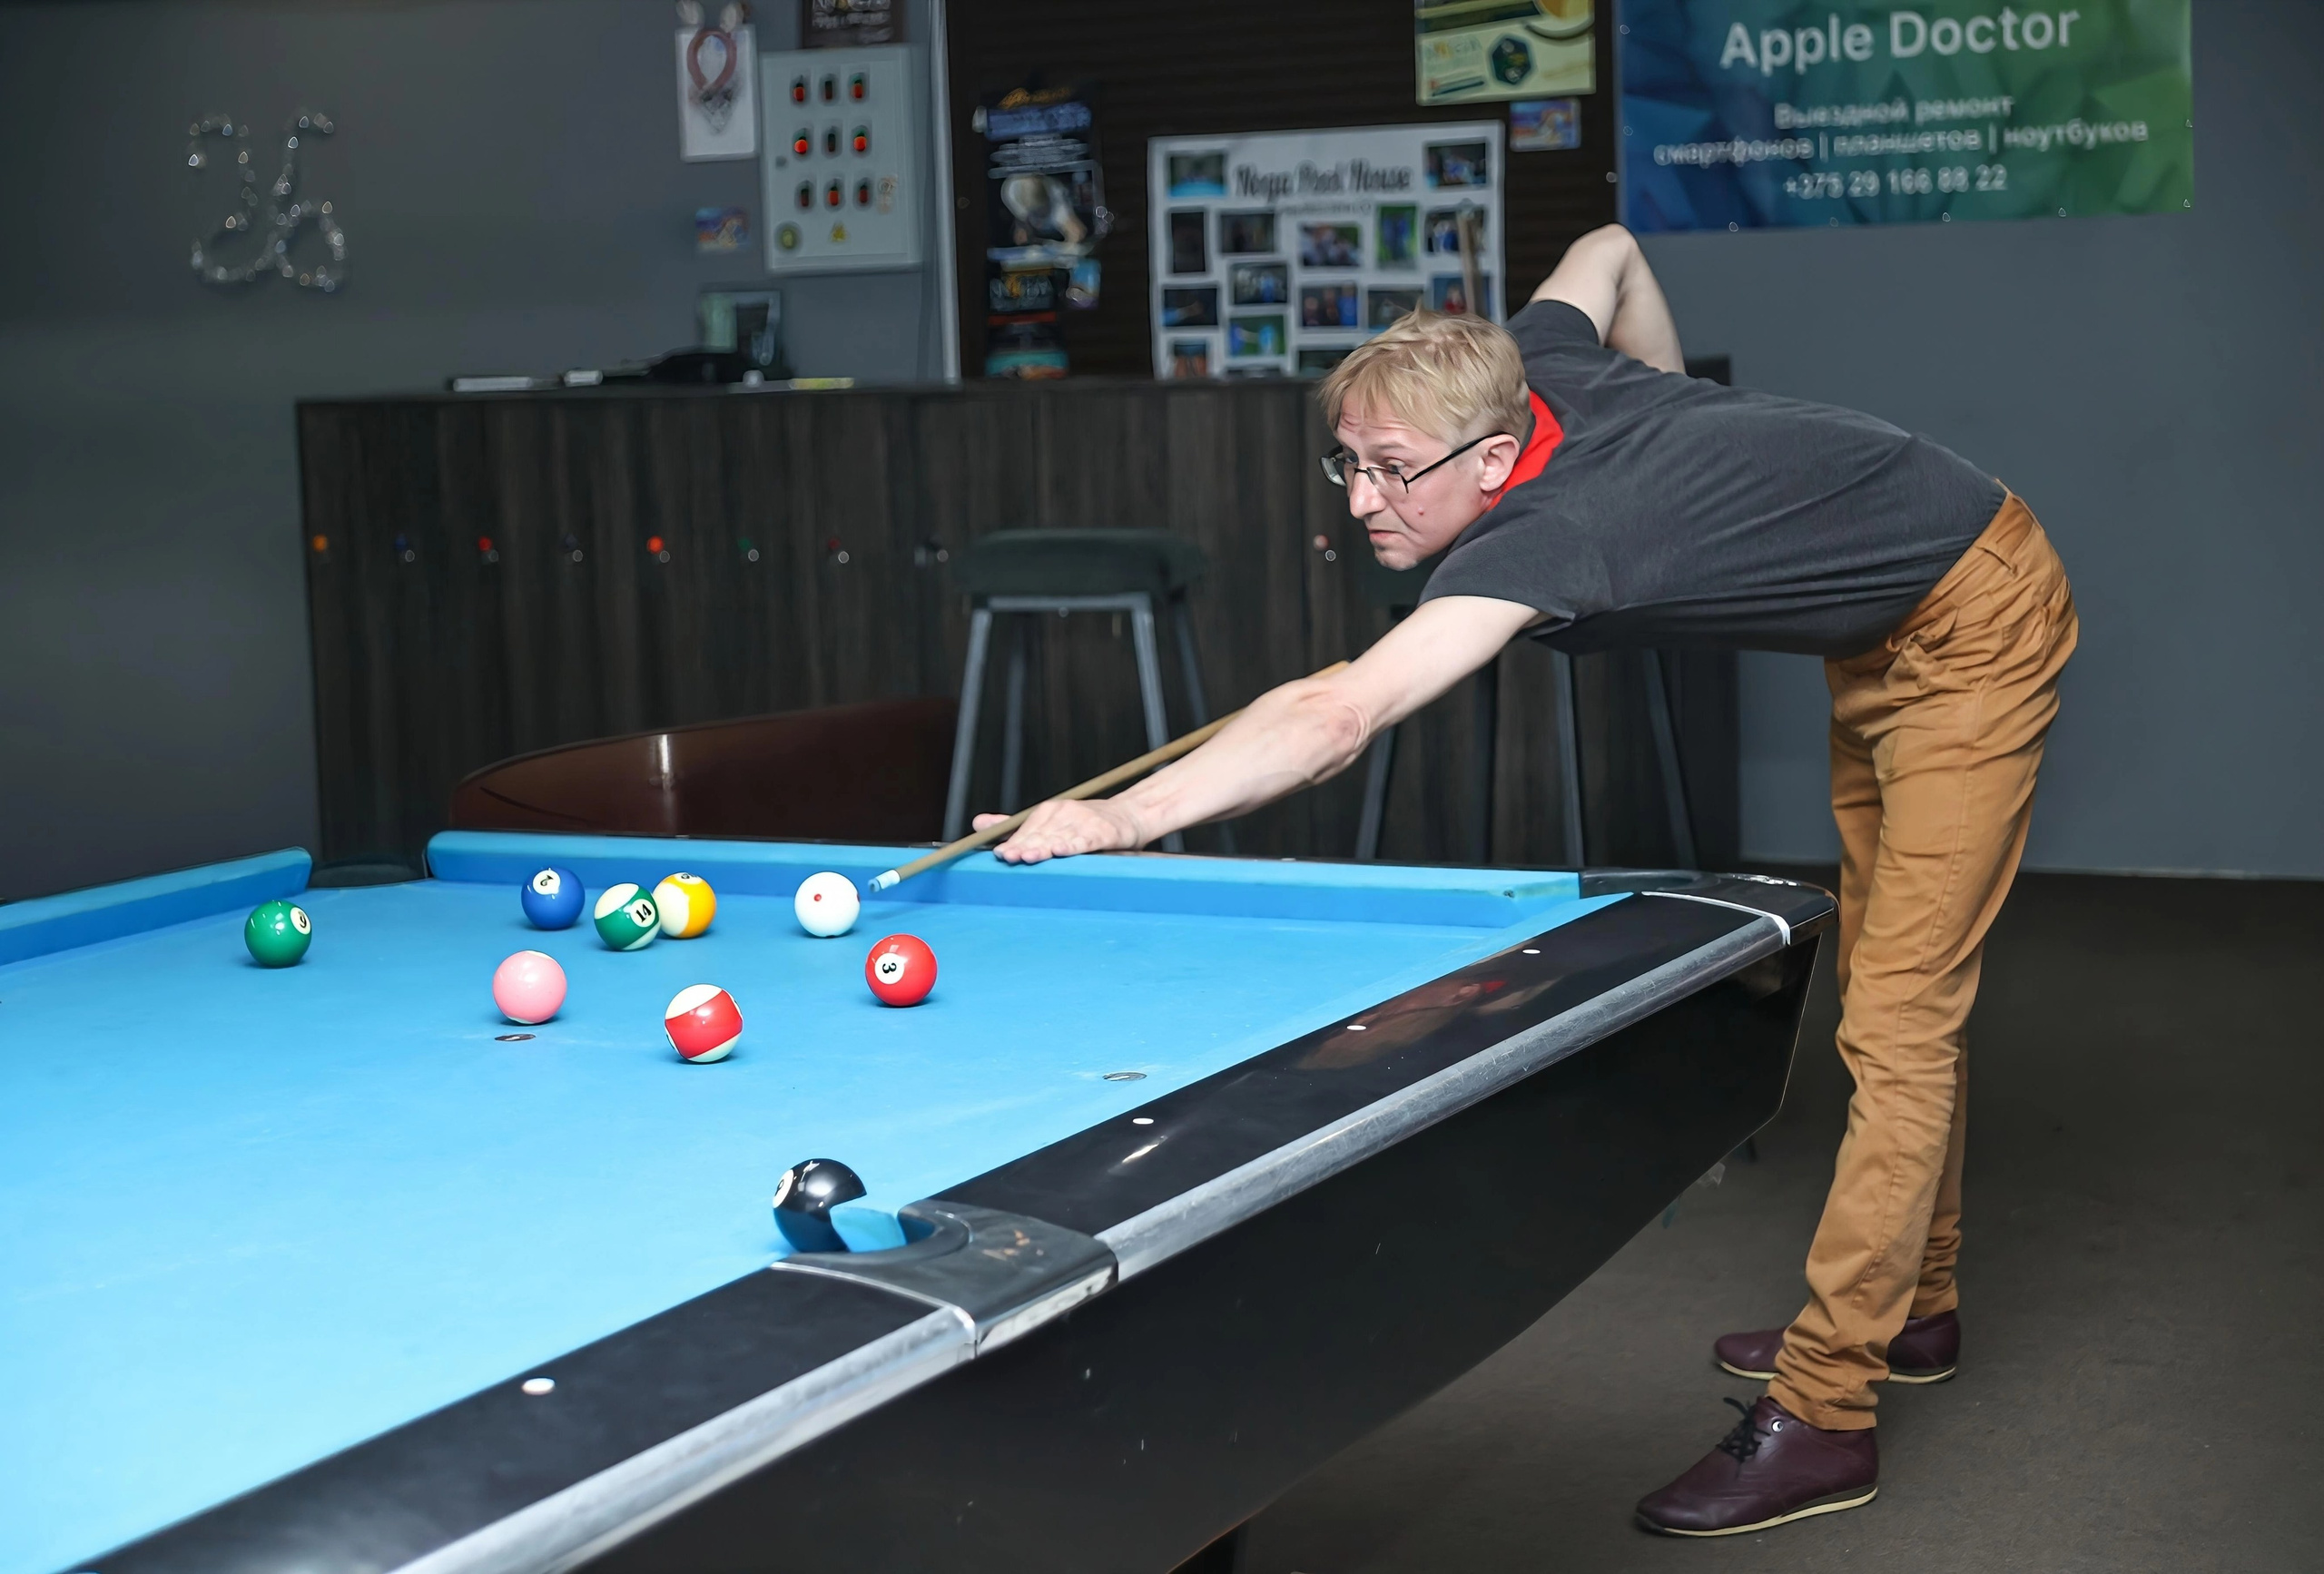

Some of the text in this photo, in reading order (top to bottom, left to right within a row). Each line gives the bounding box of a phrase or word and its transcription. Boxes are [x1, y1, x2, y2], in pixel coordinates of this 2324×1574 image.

[1719, 7, 2081, 76] Apple Doctor
[1774, 96, 2014, 129] Выездной ремонт
[1653, 135, 1816, 169] смартфонов
[1833, 128, 1983, 157] планшетов
[2003, 117, 2150, 153] ноутбуков
[1975, 163, 2009, 192] 22
[635, 903, 653, 922] 14
[881, 962, 897, 974] 3
